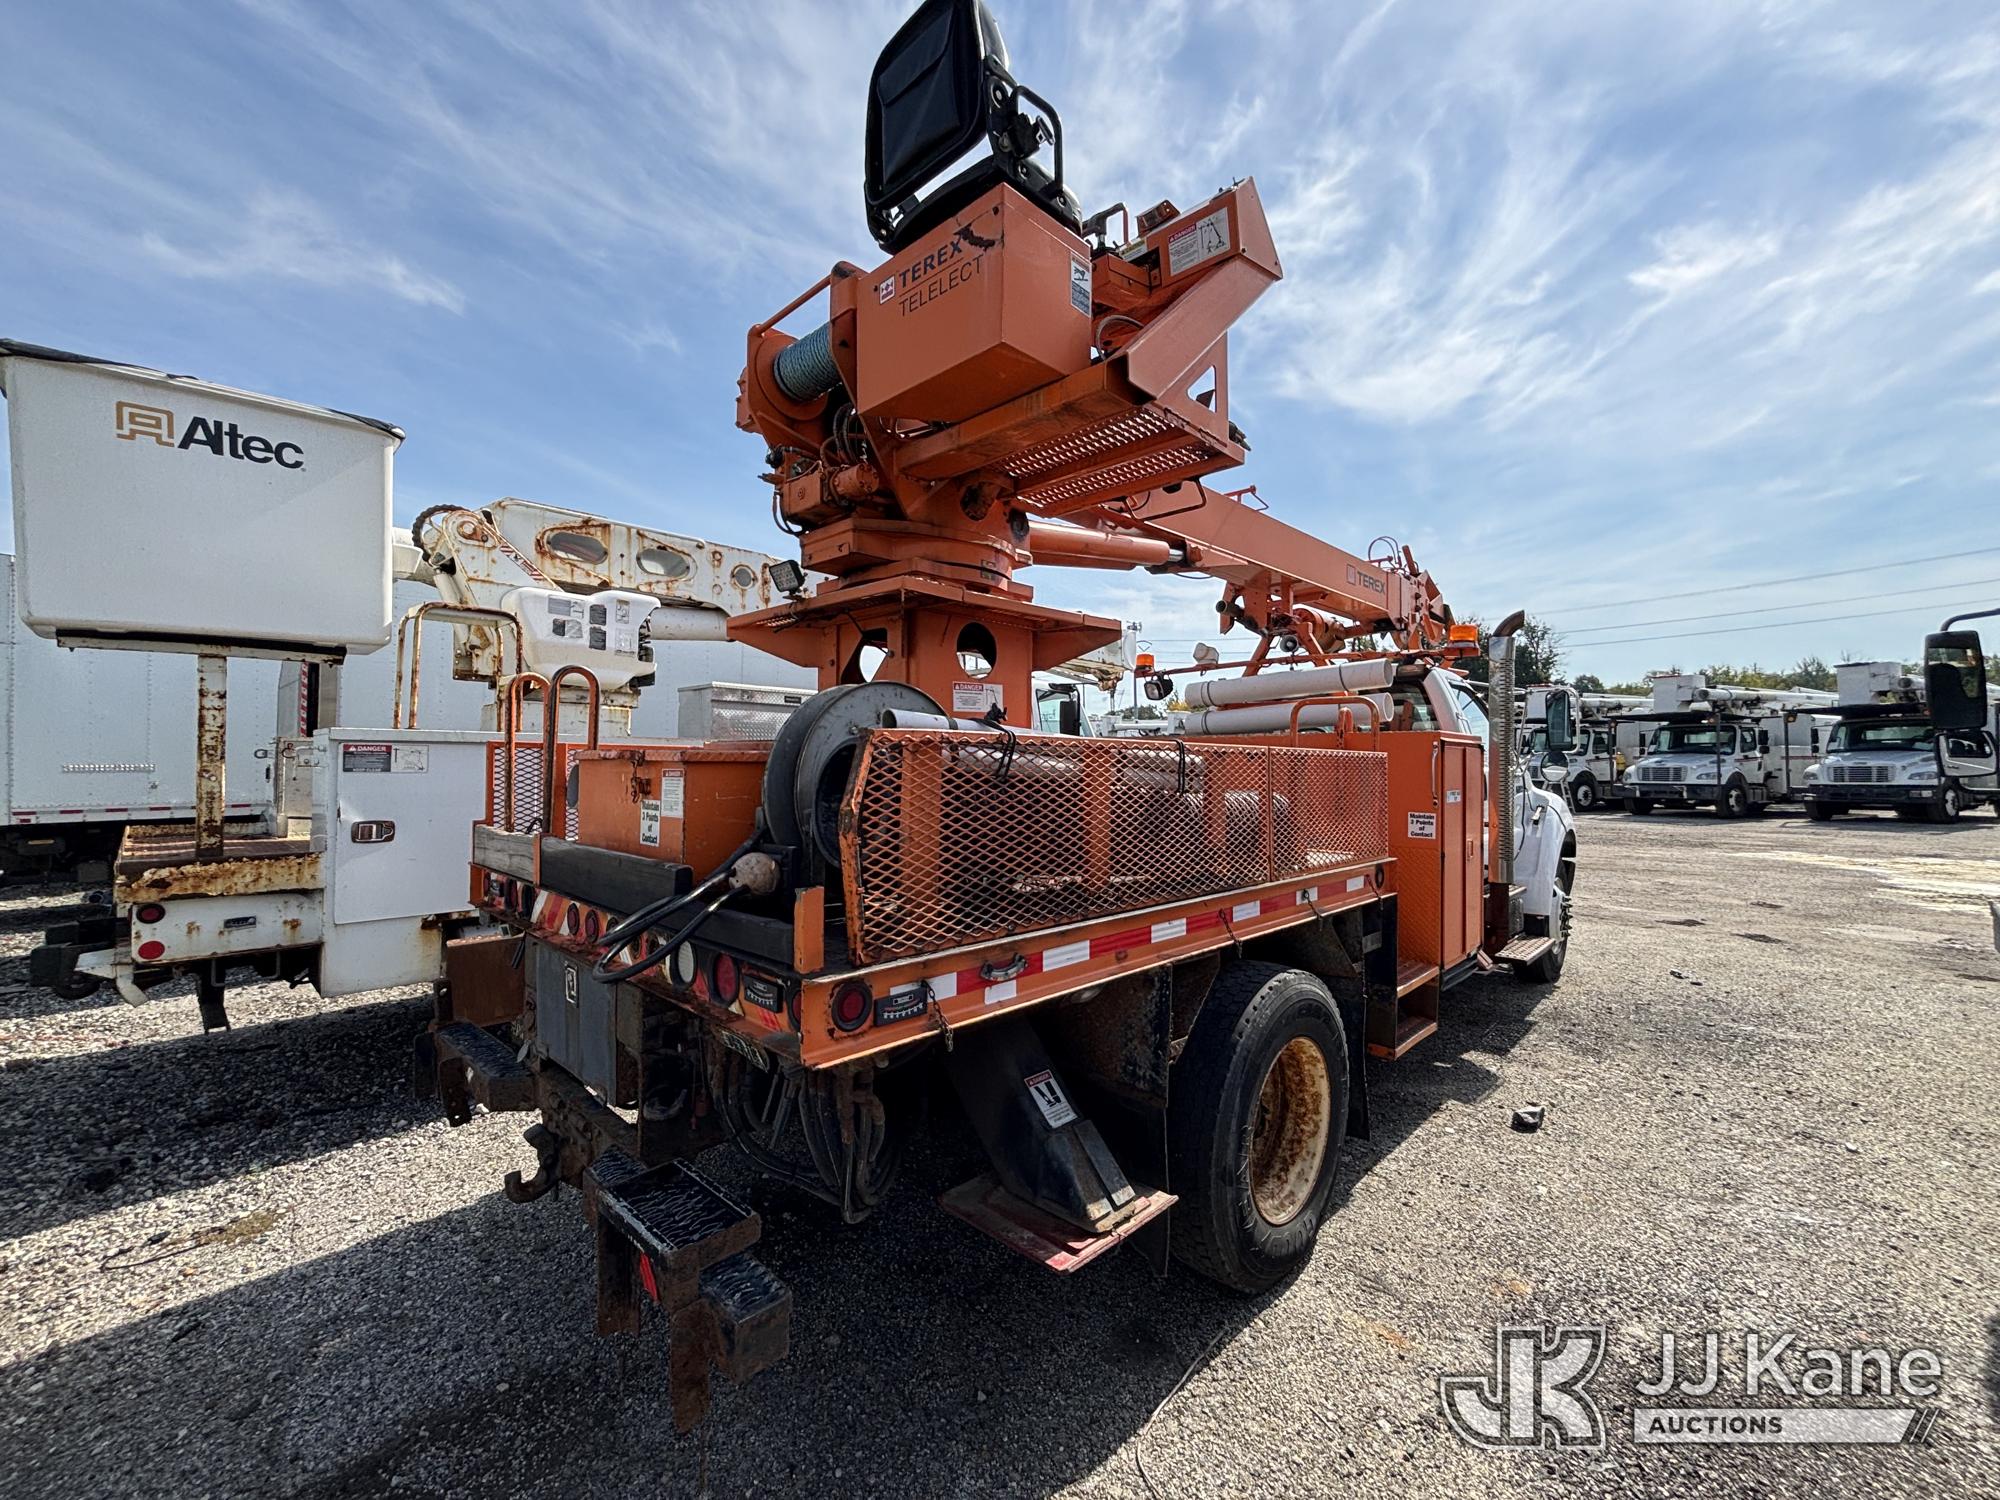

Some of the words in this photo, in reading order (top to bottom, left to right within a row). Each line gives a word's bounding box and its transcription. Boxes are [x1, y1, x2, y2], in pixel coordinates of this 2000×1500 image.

[899, 239, 962, 288] TEREX
[899, 254, 983, 317] TELELECT
[177, 416, 304, 469] Altec
[1357, 571, 1386, 595] TEREX
